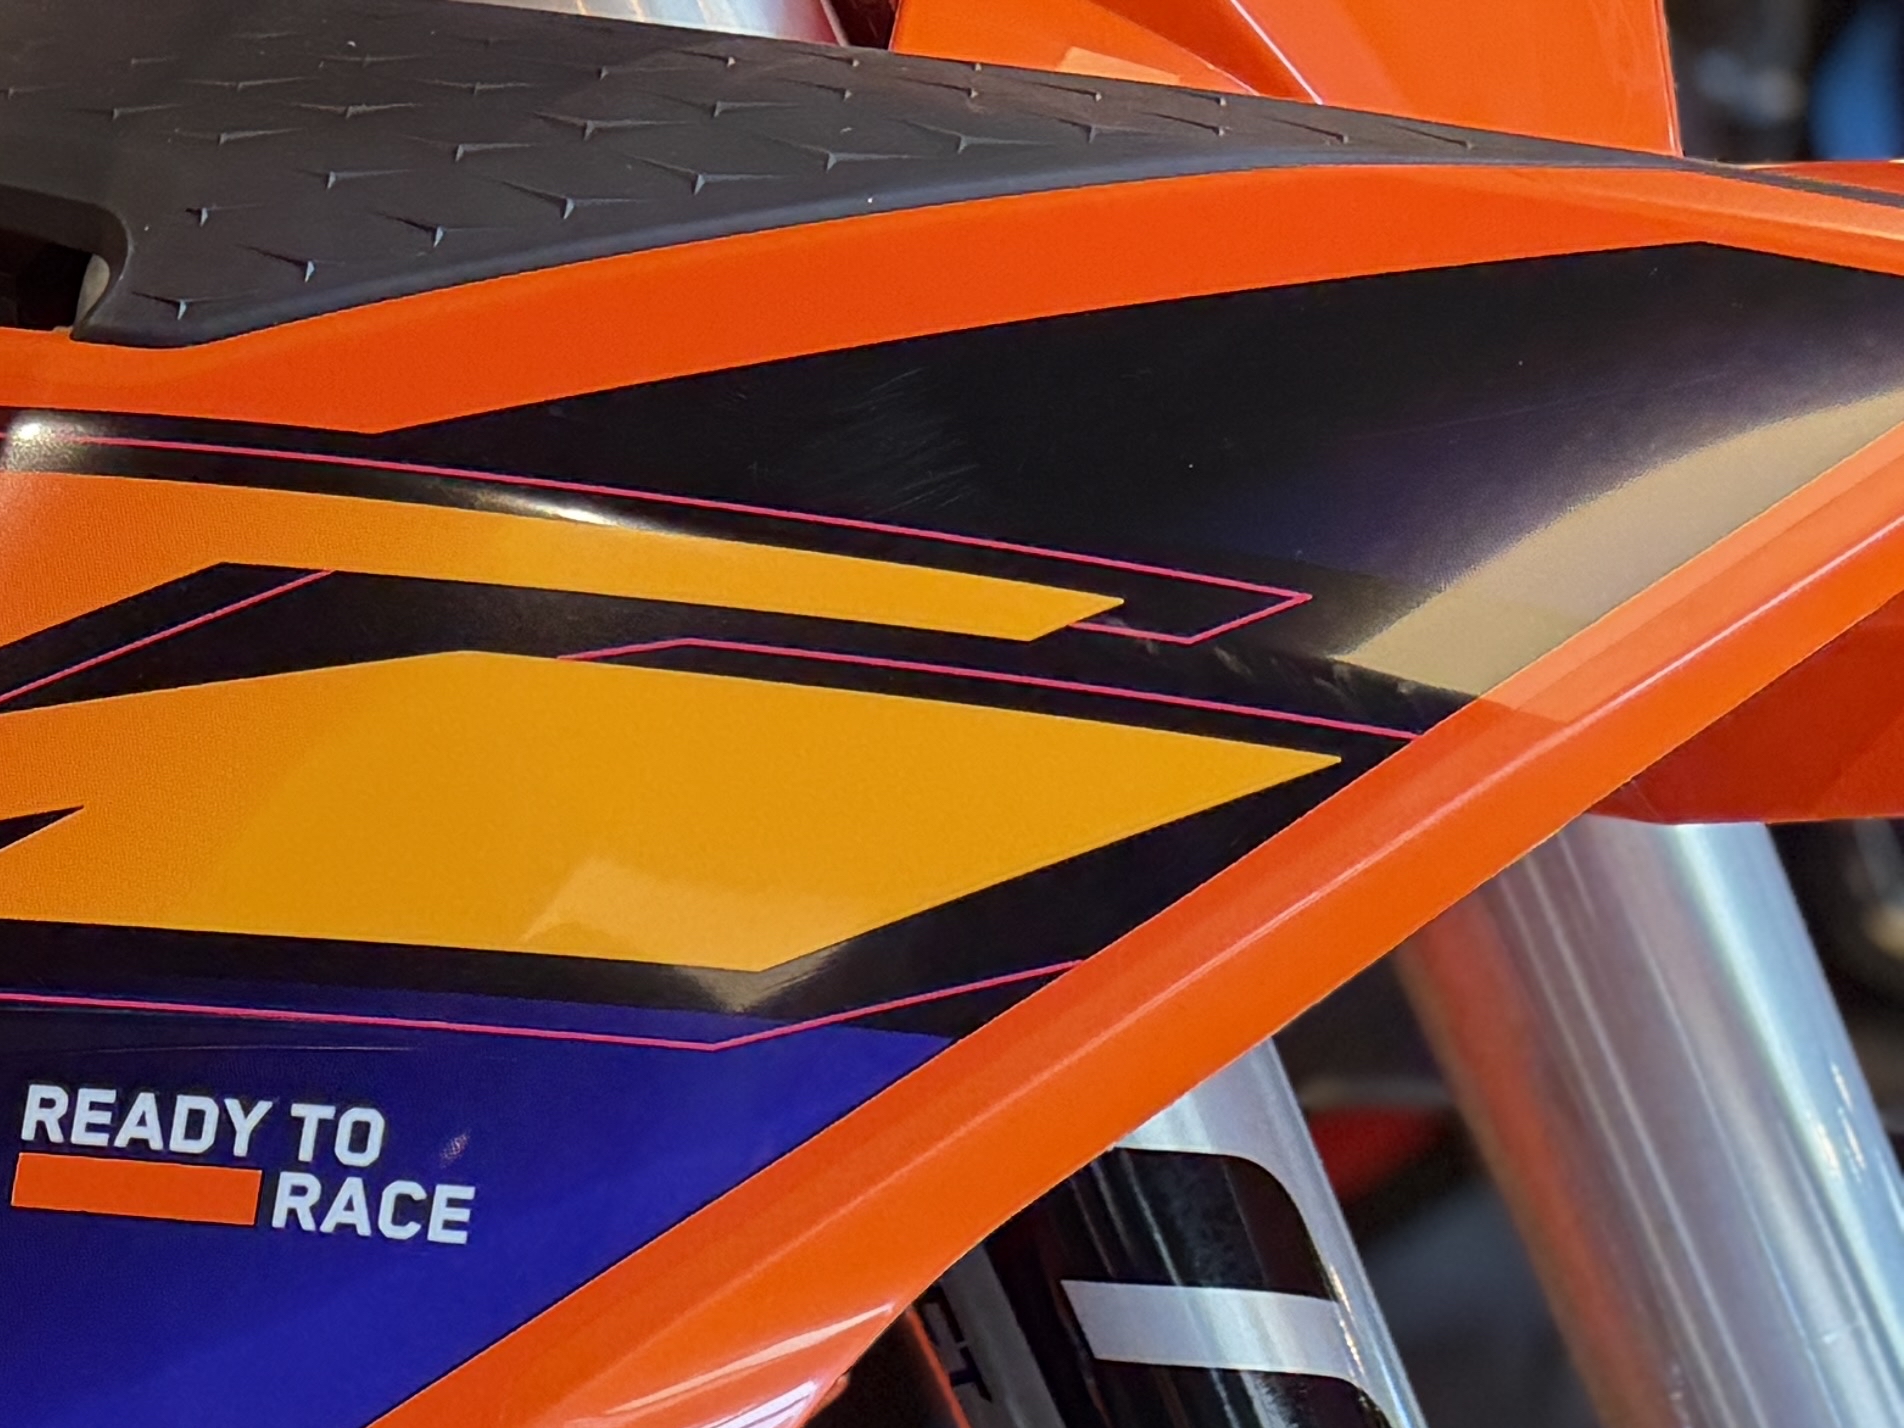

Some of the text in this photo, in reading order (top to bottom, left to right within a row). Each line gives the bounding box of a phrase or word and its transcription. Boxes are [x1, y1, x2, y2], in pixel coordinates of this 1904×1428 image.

[20, 1083, 386, 1168] READY TO
[271, 1172, 475, 1245] RACE
